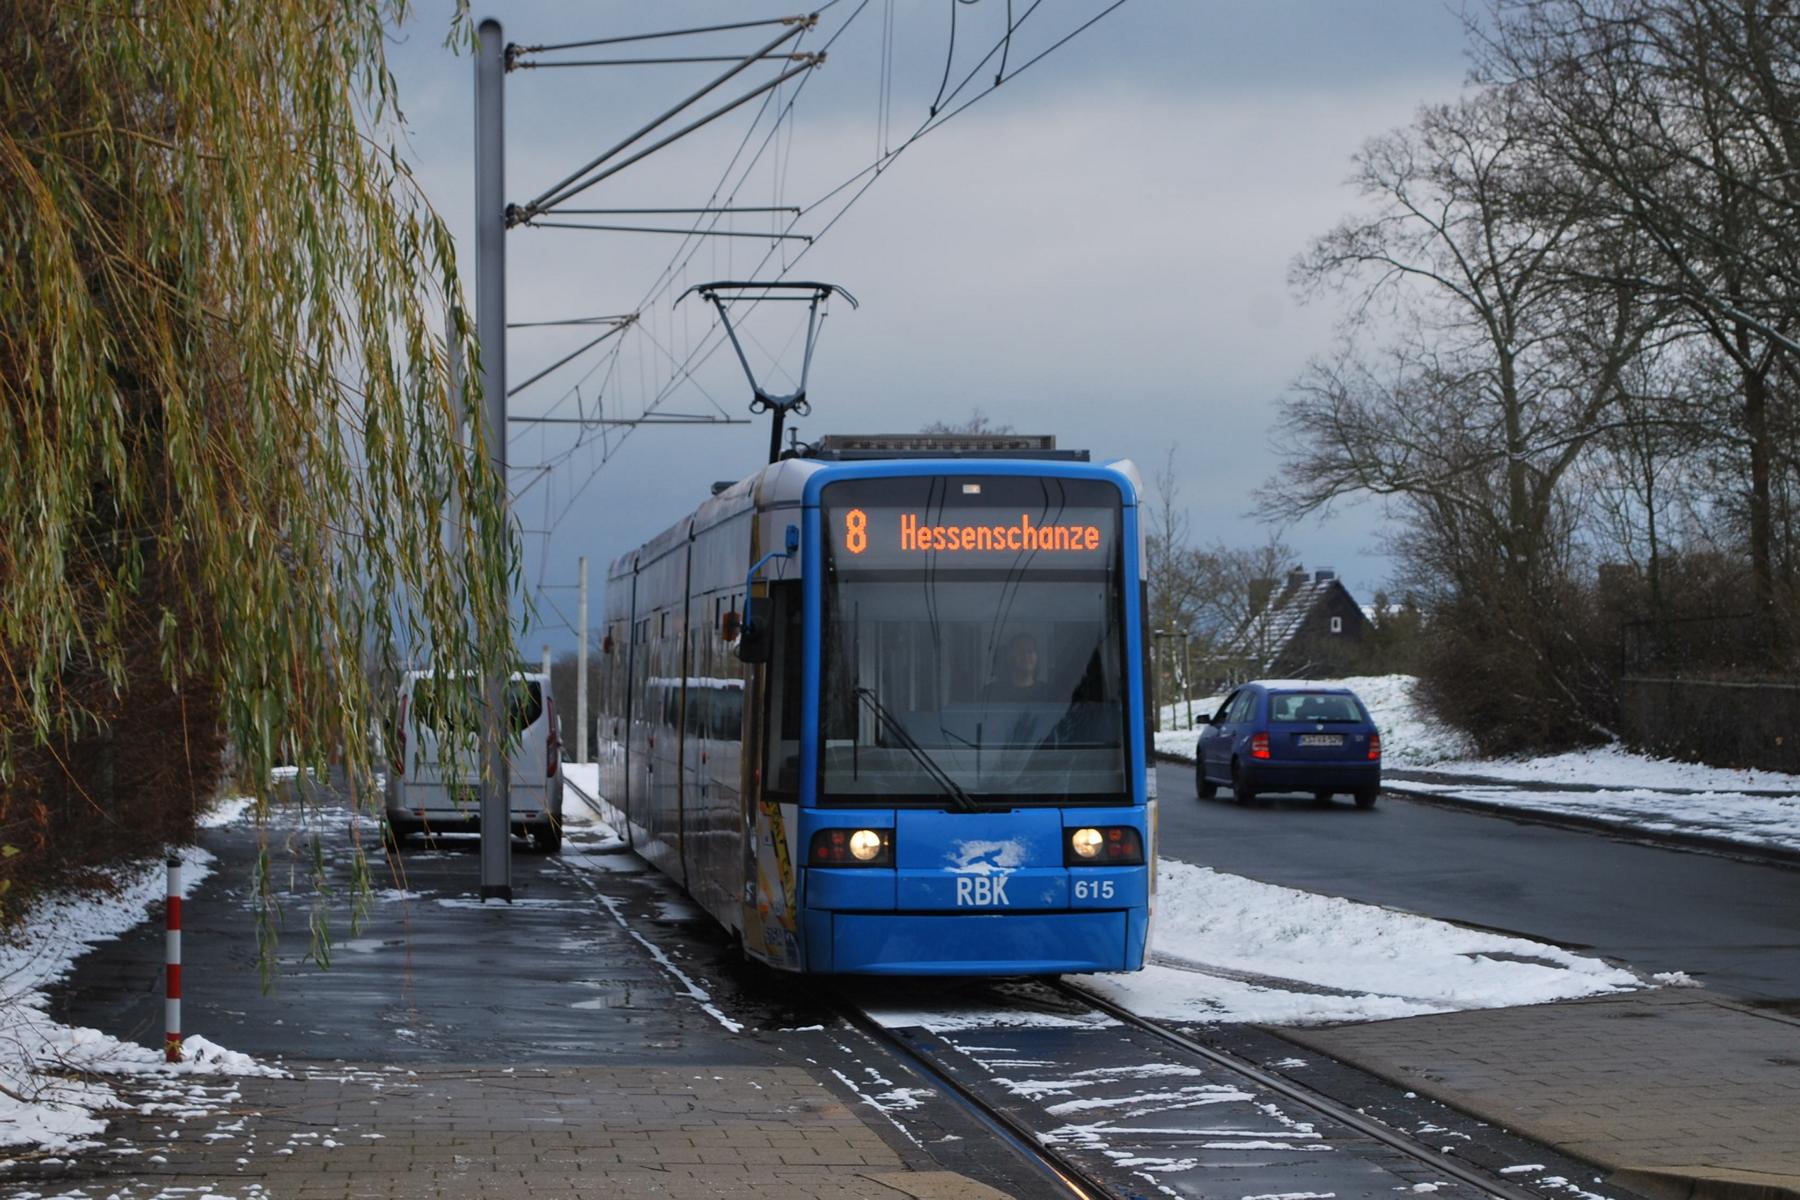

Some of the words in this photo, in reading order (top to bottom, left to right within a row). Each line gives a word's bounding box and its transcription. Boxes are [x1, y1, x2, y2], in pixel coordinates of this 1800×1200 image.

[846, 509, 867, 553] 8
[901, 514, 1099, 550] Hessenschanze
[957, 877, 1009, 905] RBK
[1075, 881, 1114, 899] 615
